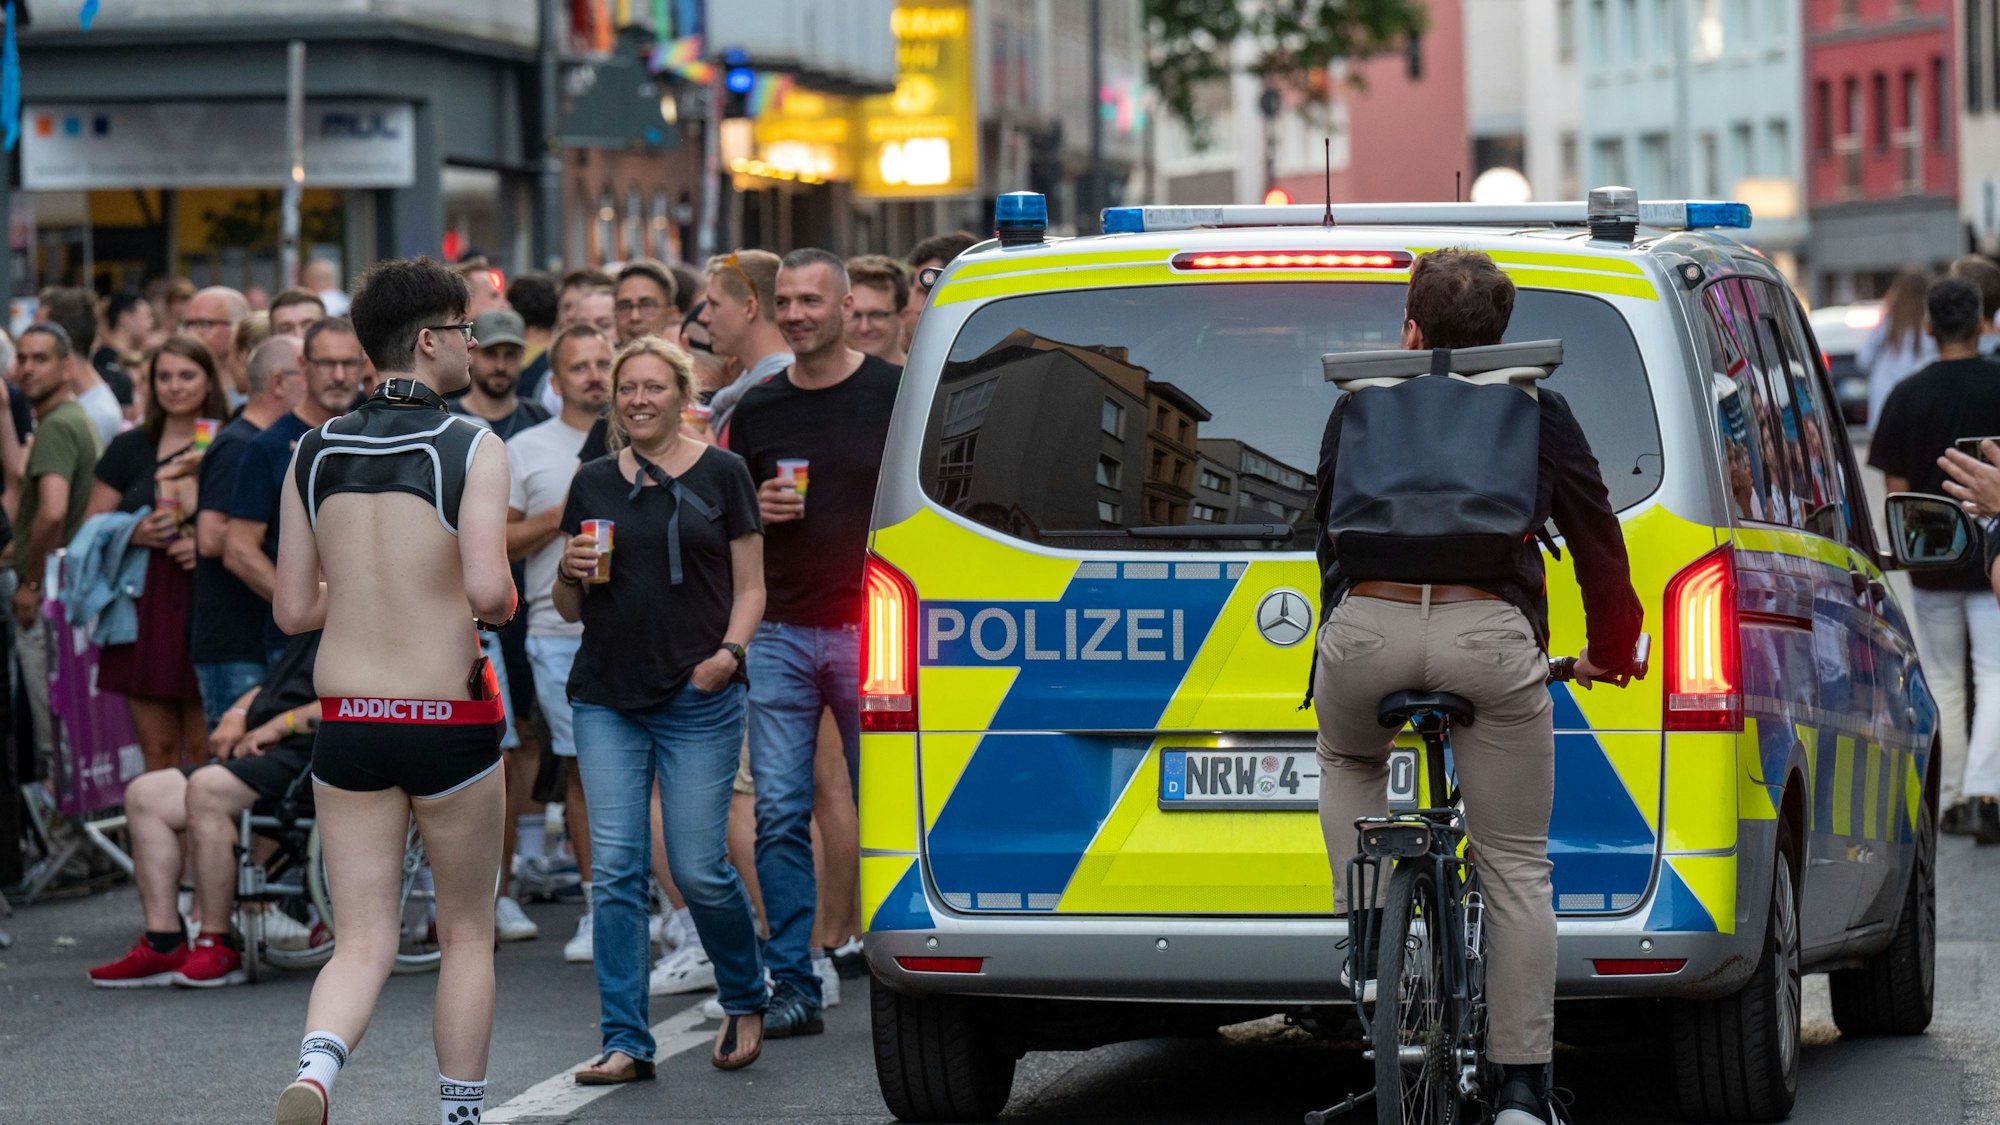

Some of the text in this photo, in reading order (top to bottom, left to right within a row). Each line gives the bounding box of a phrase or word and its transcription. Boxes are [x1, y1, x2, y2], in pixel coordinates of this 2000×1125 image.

[928, 607, 1185, 661] POLIZEI
[338, 698, 453, 720] ADDICTED
[1169, 781, 1178, 793] D
[1186, 756, 1257, 795] NRW
